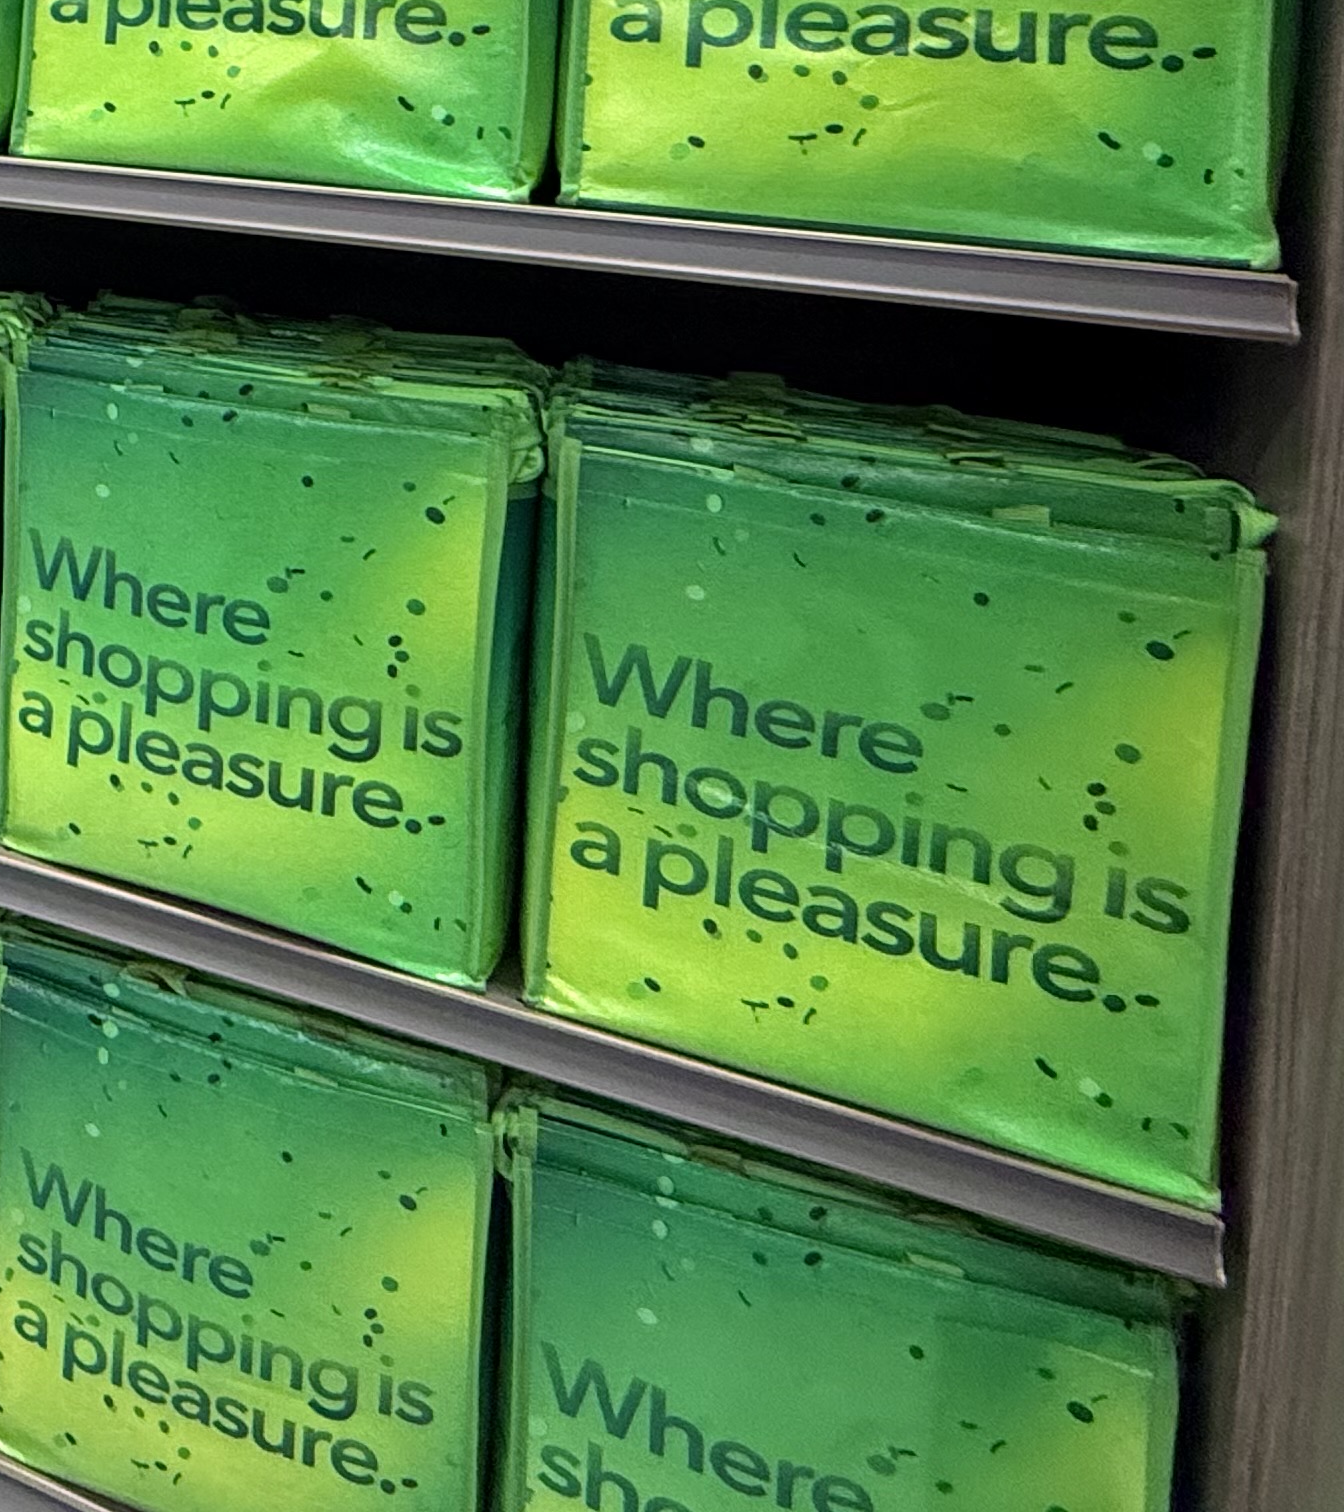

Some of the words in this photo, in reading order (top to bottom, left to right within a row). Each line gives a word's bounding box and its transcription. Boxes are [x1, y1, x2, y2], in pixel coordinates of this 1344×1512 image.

[31, 531, 272, 648] Where
[19, 687, 54, 738] a
[67, 694, 422, 835] pleasure.
[24, 608, 383, 764] shopping
[403, 703, 462, 760] is
[19, 1145, 253, 1300] Where
[14, 1296, 49, 1350] a
[62, 1313, 395, 1494] pleasure.
[17, 1229, 359, 1422] shopping
[378, 1365, 435, 1426] is
[541, 1341, 875, 1512] Where
